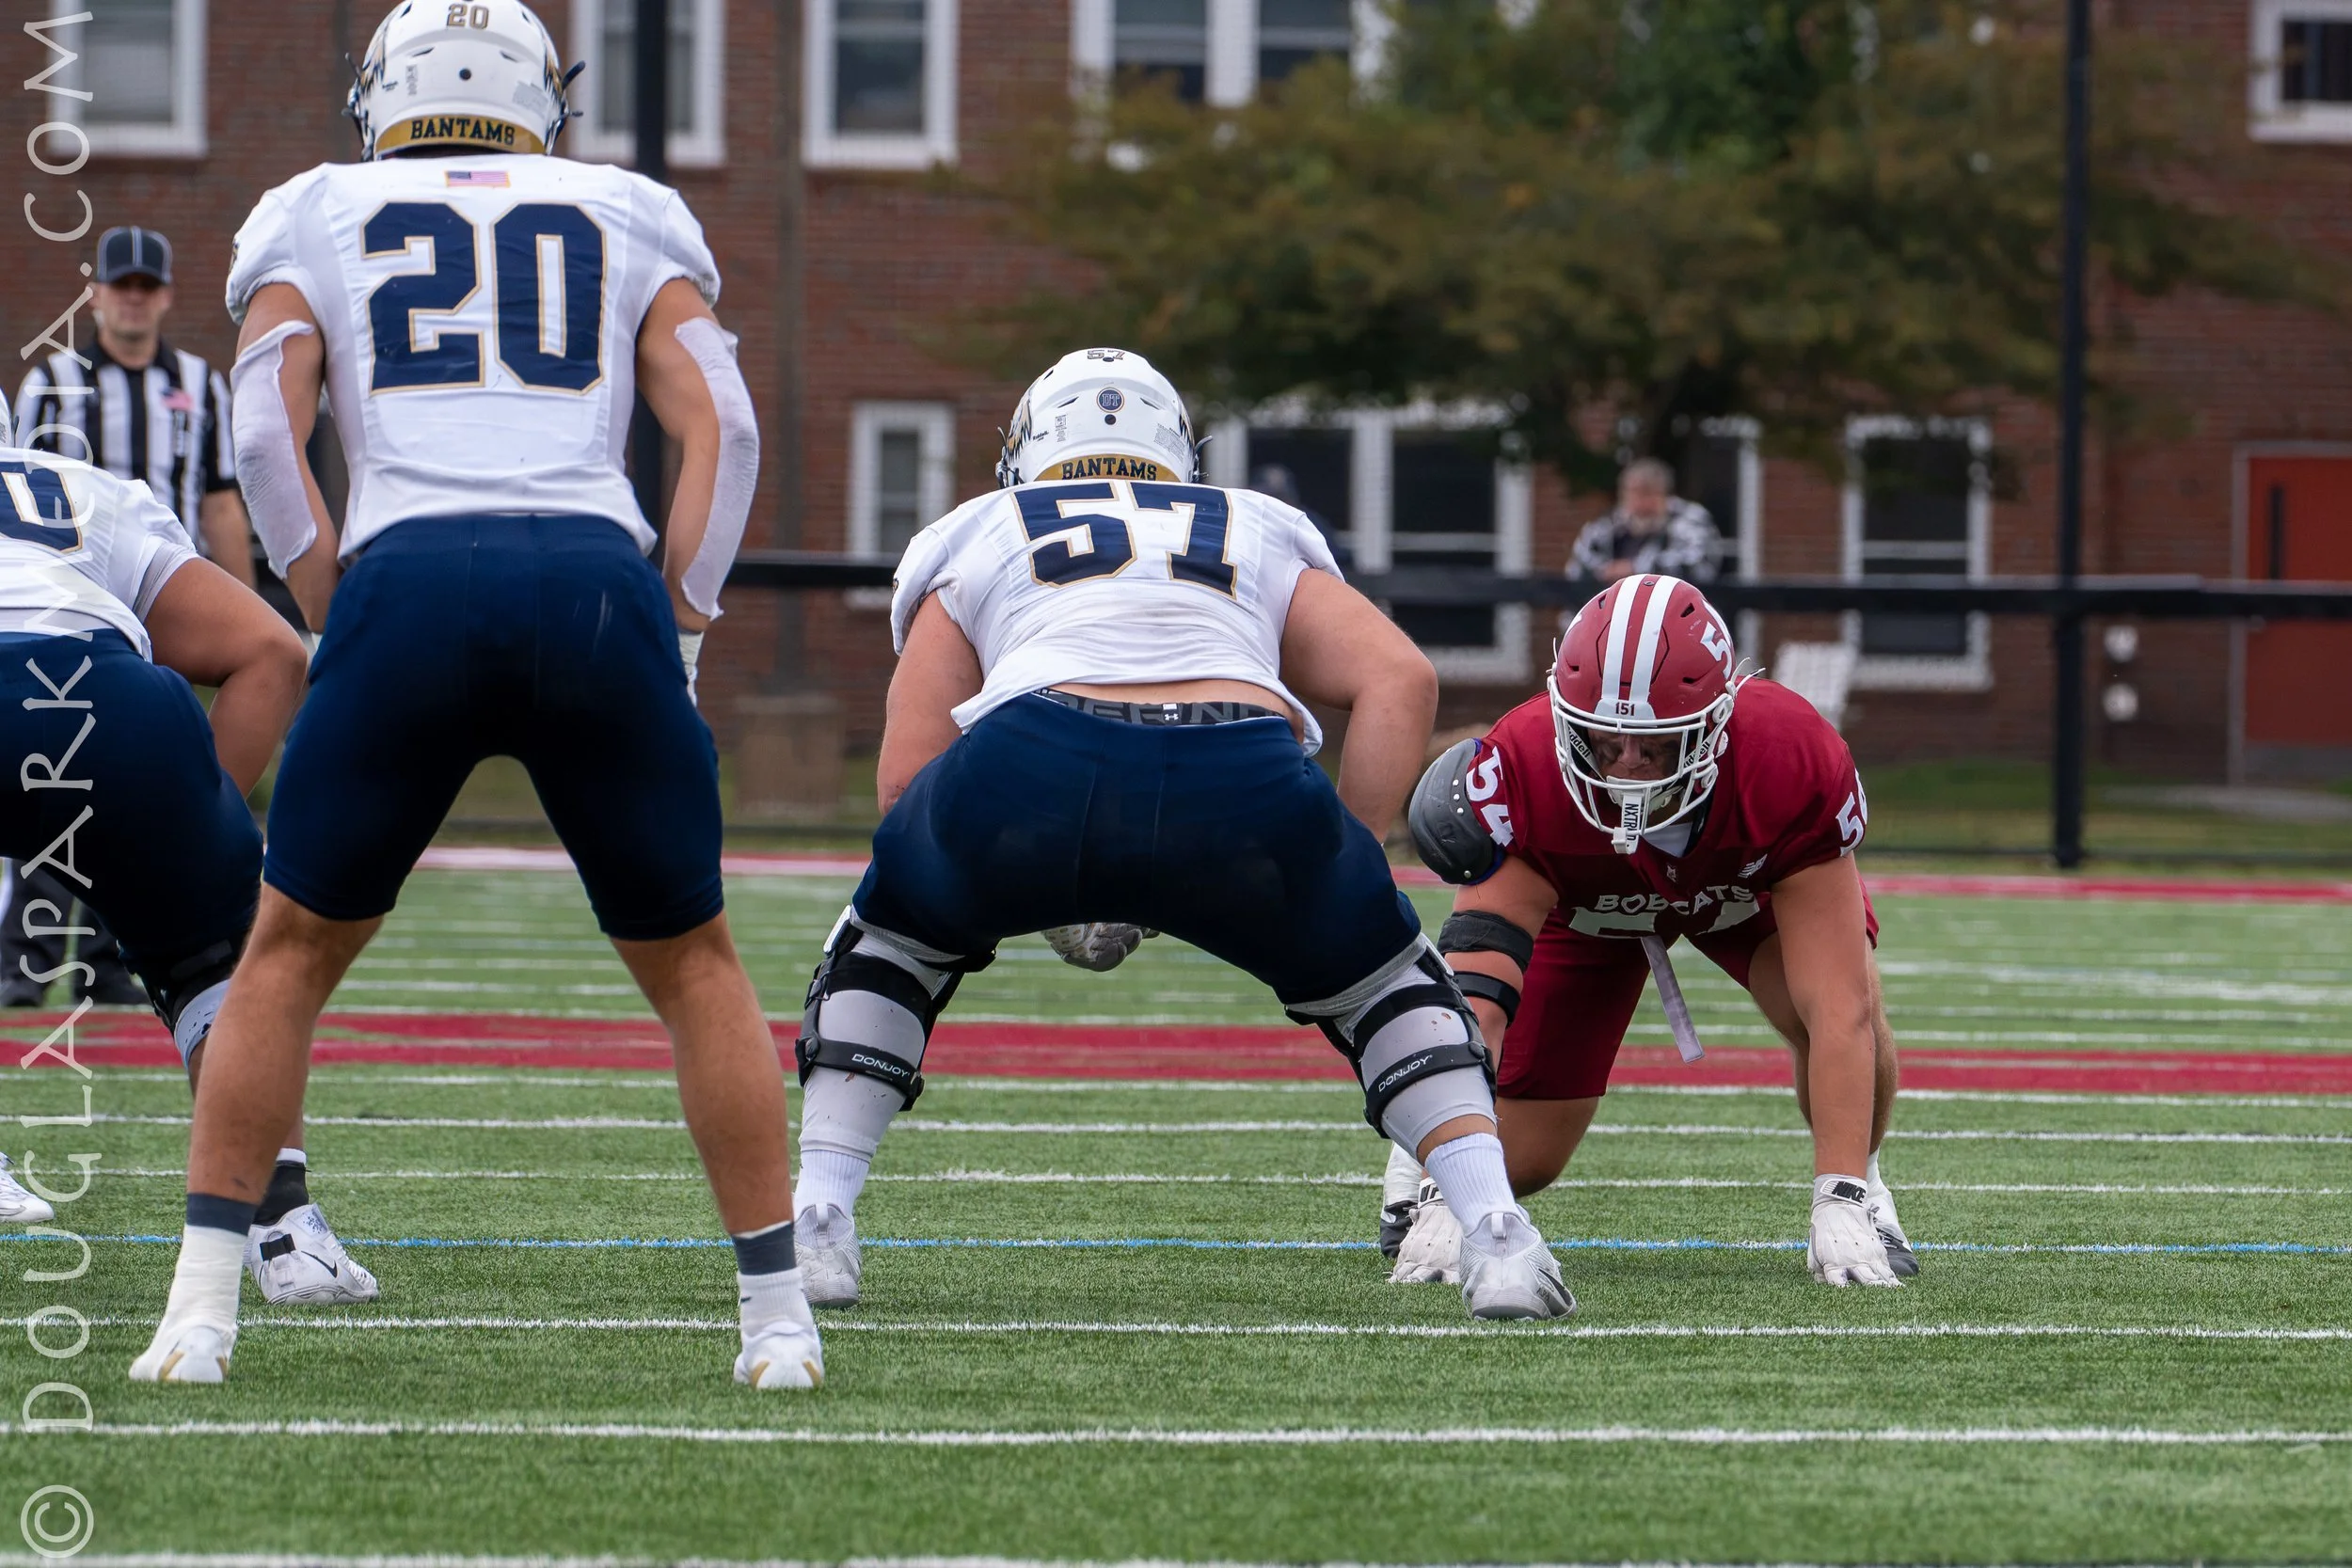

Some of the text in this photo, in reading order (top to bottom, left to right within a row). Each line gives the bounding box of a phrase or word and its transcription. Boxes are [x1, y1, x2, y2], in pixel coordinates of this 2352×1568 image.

[447, 3, 490, 30] 20
[410, 117, 516, 146] BANTAMS
[358, 197, 608, 398] 20
[1087, 349, 1127, 361] 57
[1061, 457, 1158, 482] BANTAMS
[1009, 479, 1238, 602] 57
[1614, 702, 1635, 717] 151
[1466, 745, 1515, 847] 54
[1831, 1180, 1867, 1204] NIKE
